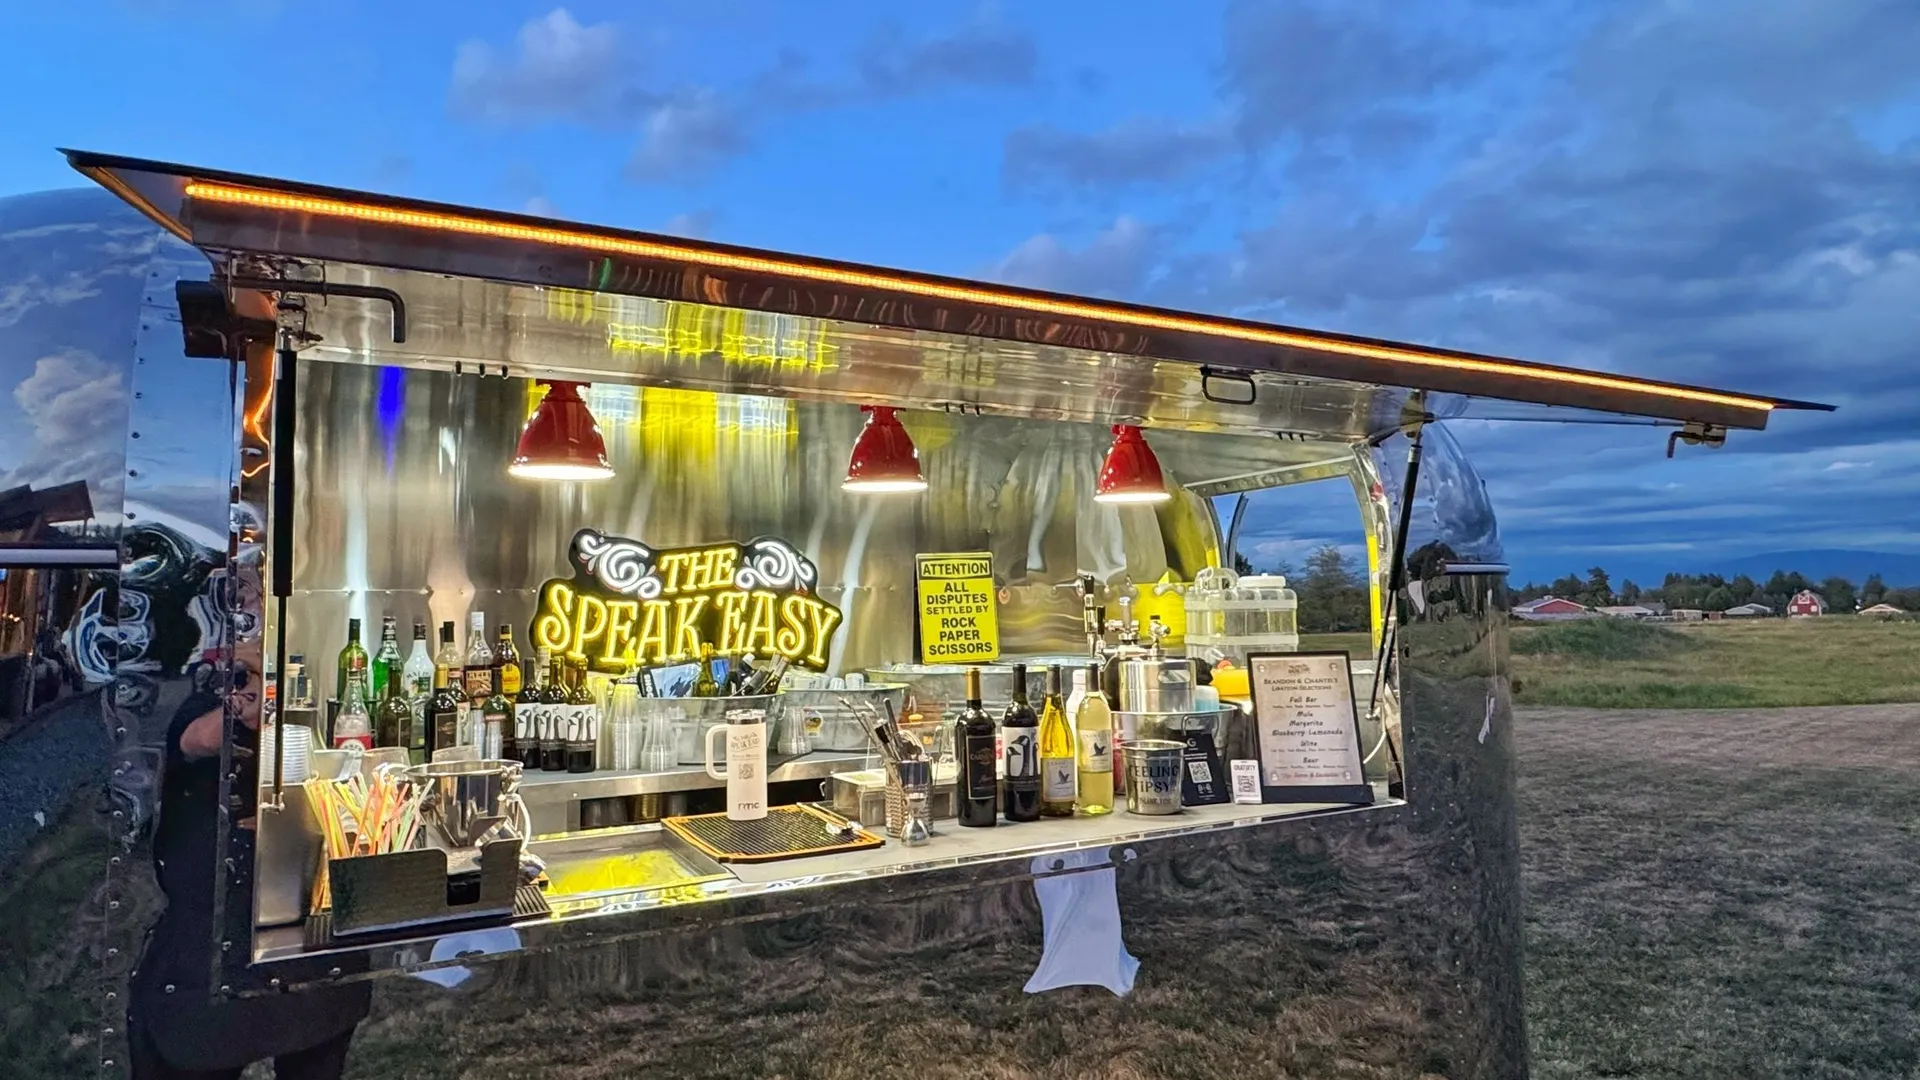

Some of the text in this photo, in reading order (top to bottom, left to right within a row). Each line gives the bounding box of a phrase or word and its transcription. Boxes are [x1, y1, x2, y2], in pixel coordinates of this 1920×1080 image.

[658, 547, 740, 594] THE
[922, 562, 988, 575] ATTENTION
[944, 582, 969, 592] ALL
[926, 593, 988, 605] DISPUTES
[926, 605, 989, 615] SETTLED BY
[538, 582, 841, 664] SPEAK EASY
[941, 616, 977, 628] ROCK
[939, 629, 980, 641] PAPER
[928, 642, 993, 656] SCISSORS
[1272, 728, 1343, 737] Blueberry Lemonade
[1129, 765, 1180, 778] FEELING
